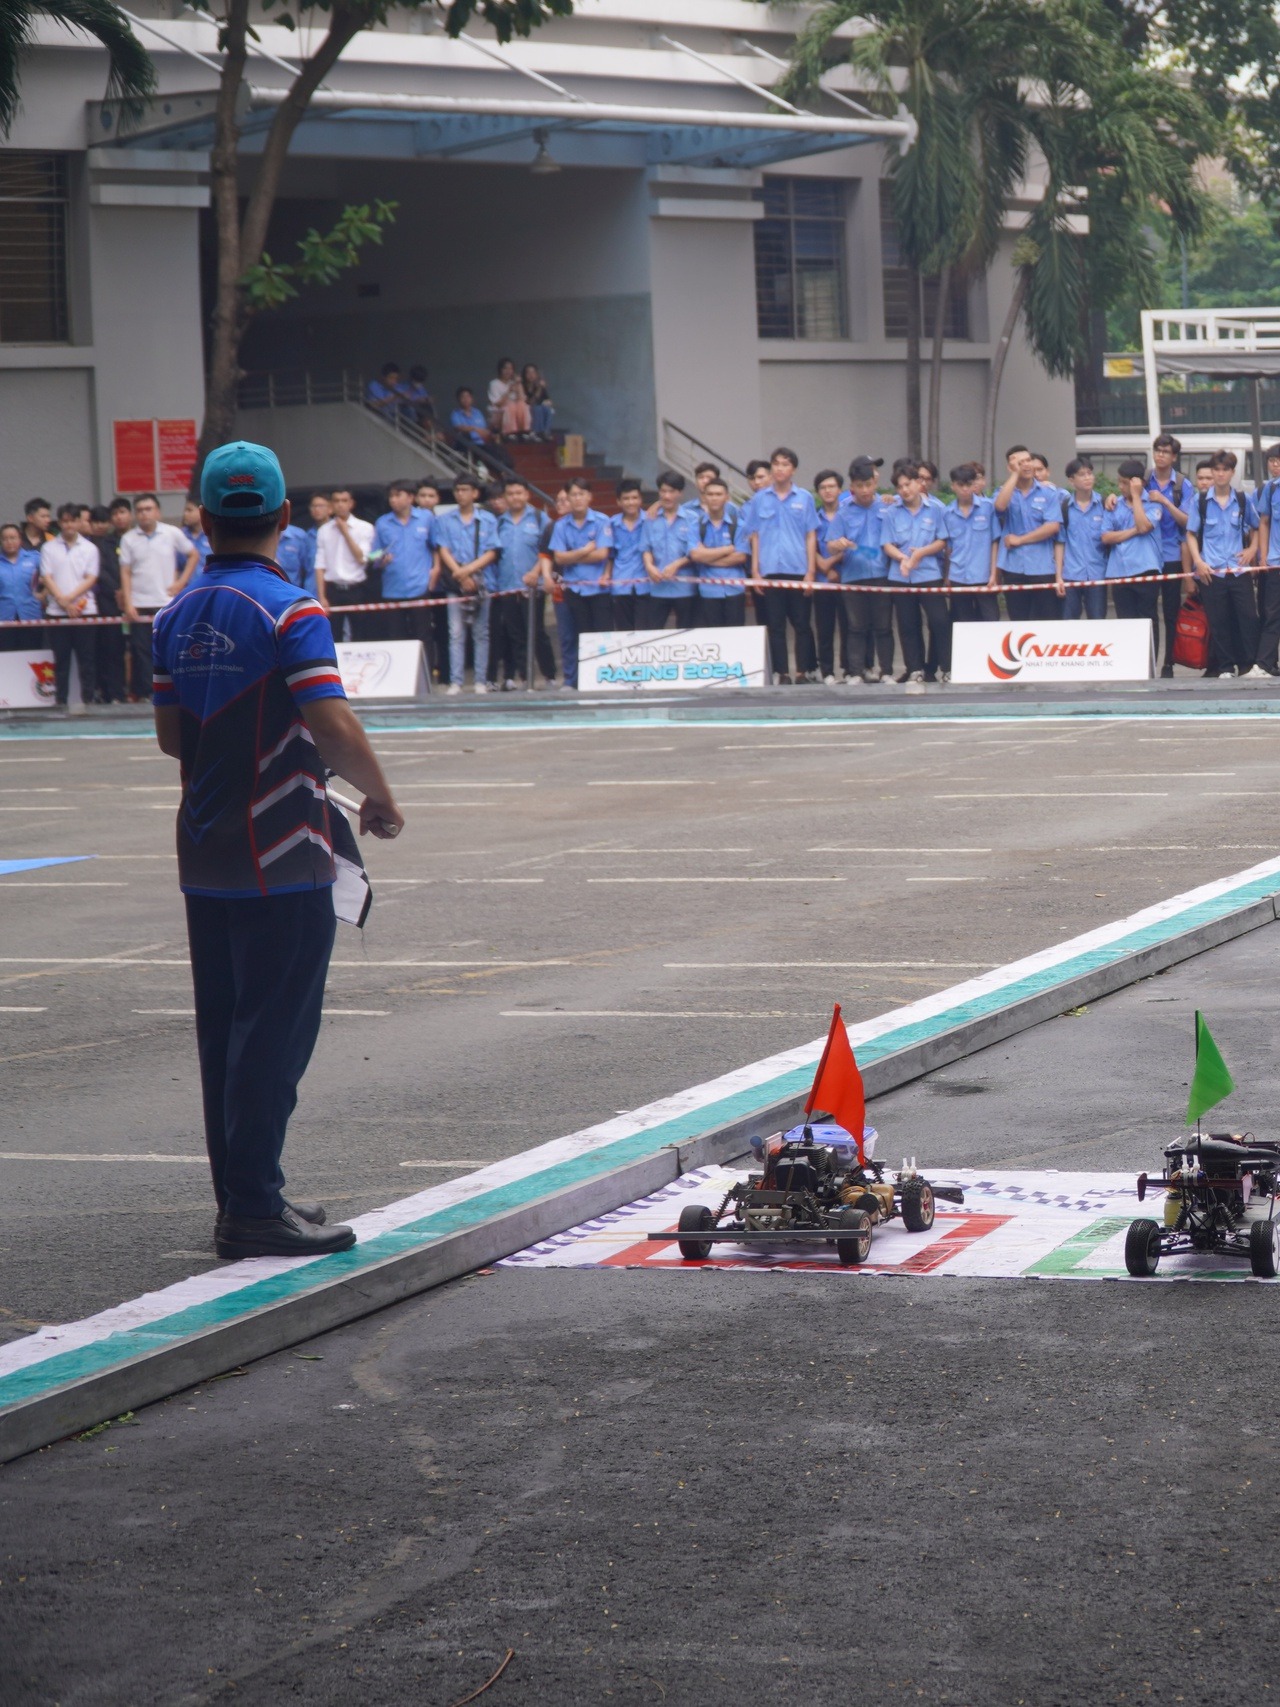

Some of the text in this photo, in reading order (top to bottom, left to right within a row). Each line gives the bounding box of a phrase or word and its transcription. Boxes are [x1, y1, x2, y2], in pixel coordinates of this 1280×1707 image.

[620, 643, 721, 664] MINICAR
[596, 661, 744, 683] RACING 2024
